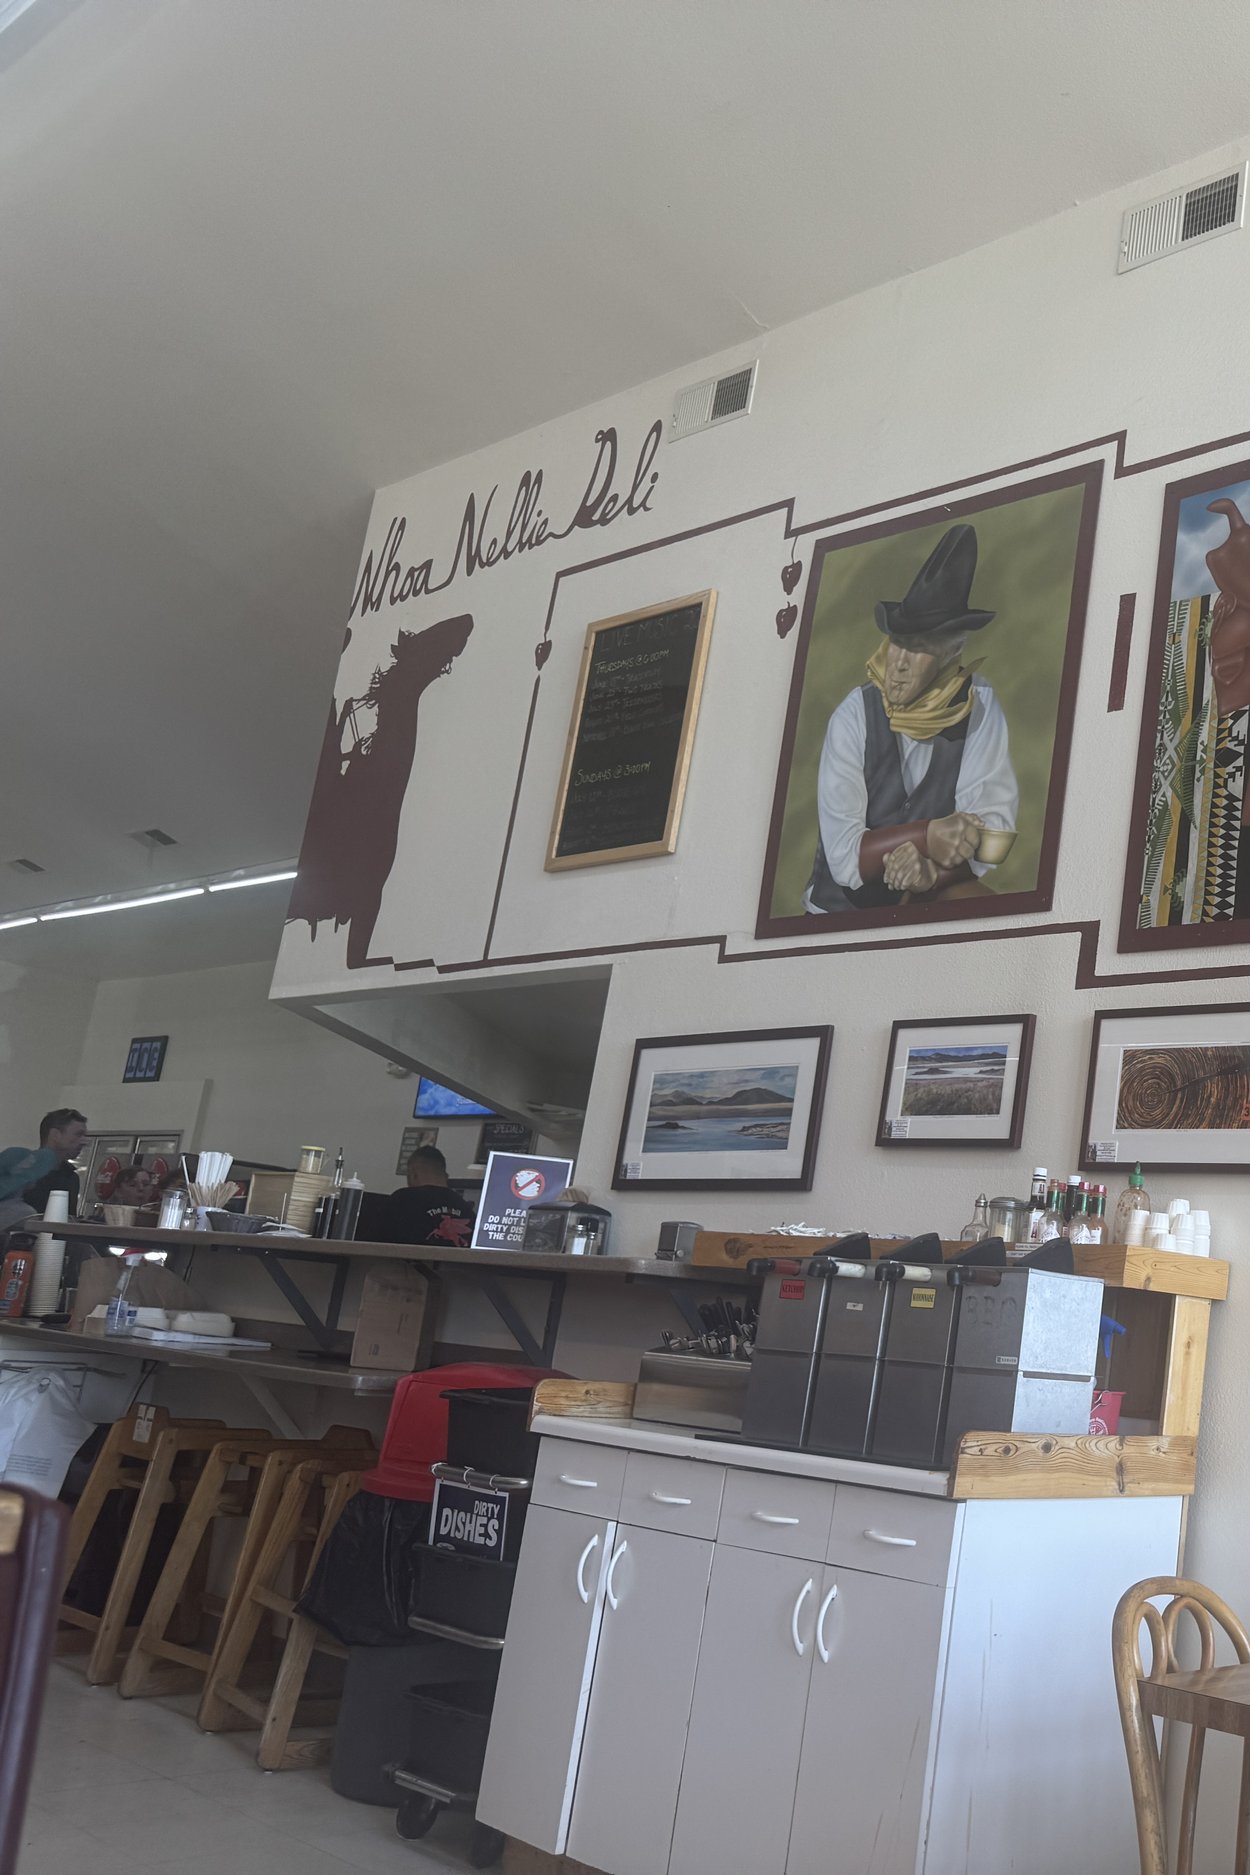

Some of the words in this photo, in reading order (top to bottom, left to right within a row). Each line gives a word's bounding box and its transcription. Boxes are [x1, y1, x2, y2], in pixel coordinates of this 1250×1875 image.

[452, 469, 566, 577] Nellie
[566, 419, 663, 530] Deli
[574, 767, 612, 788] SUNDAYS
[426, 1207, 442, 1217] The
[505, 1208, 527, 1218] PLEA
[488, 1215, 500, 1224] DO
[501, 1216, 518, 1225] NOT
[483, 1222, 508, 1233] DIRTY
[510, 1225, 525, 1235] DIS
[488, 1231, 505, 1241] THE
[507, 1233, 524, 1242] COU
[473, 1500, 501, 1519] DIRTY
[439, 1507, 500, 1548] DISHES
